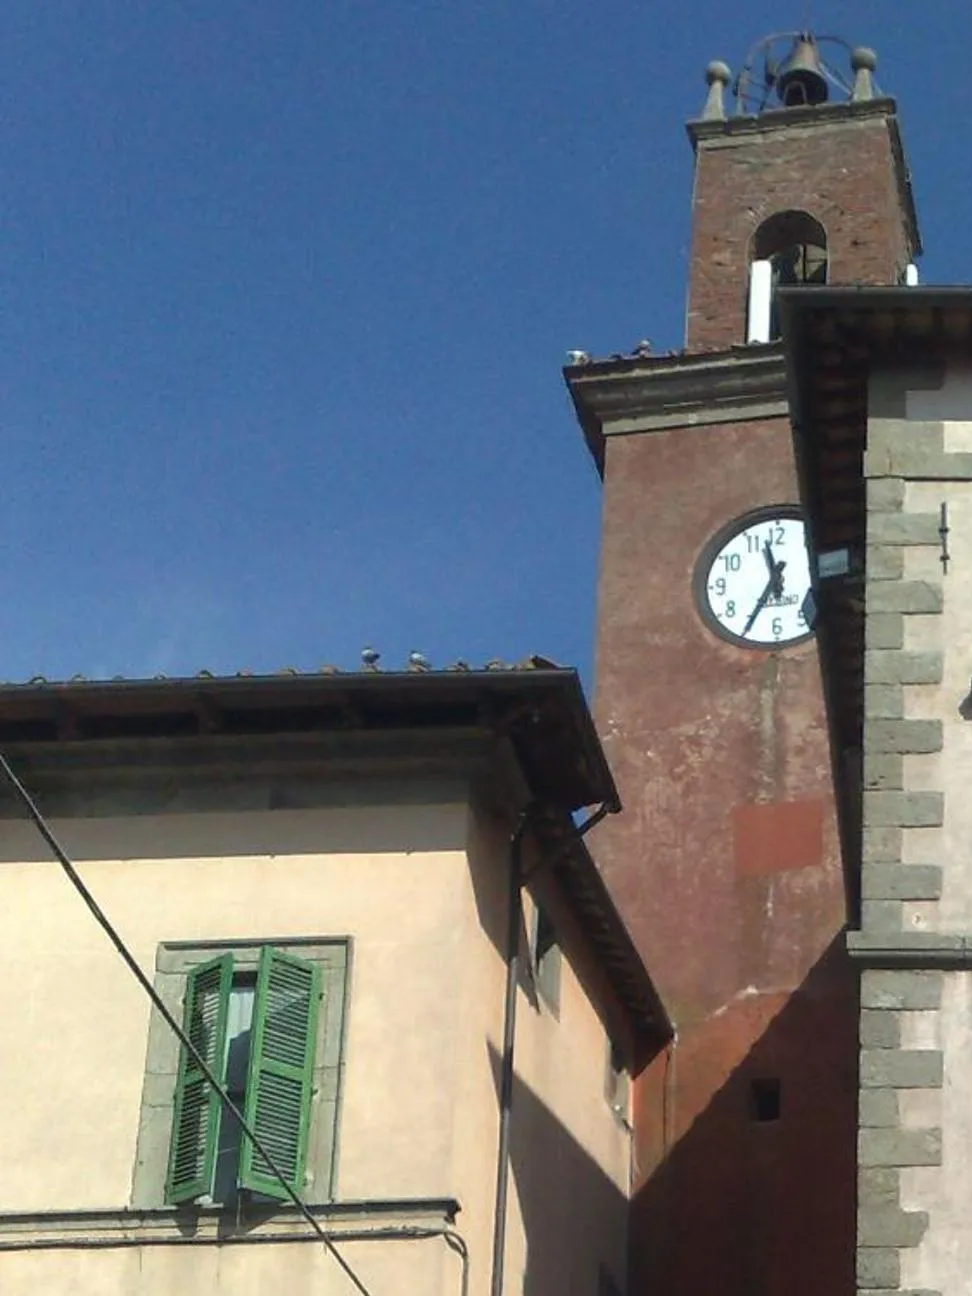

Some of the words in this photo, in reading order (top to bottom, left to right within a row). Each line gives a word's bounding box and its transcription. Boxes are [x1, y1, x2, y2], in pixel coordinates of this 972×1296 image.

[746, 535, 760, 553] 11
[767, 527, 785, 546] 12
[725, 553, 741, 572] 10
[715, 577, 726, 596] 9
[725, 600, 736, 618] 8
[772, 617, 782, 636] 6
